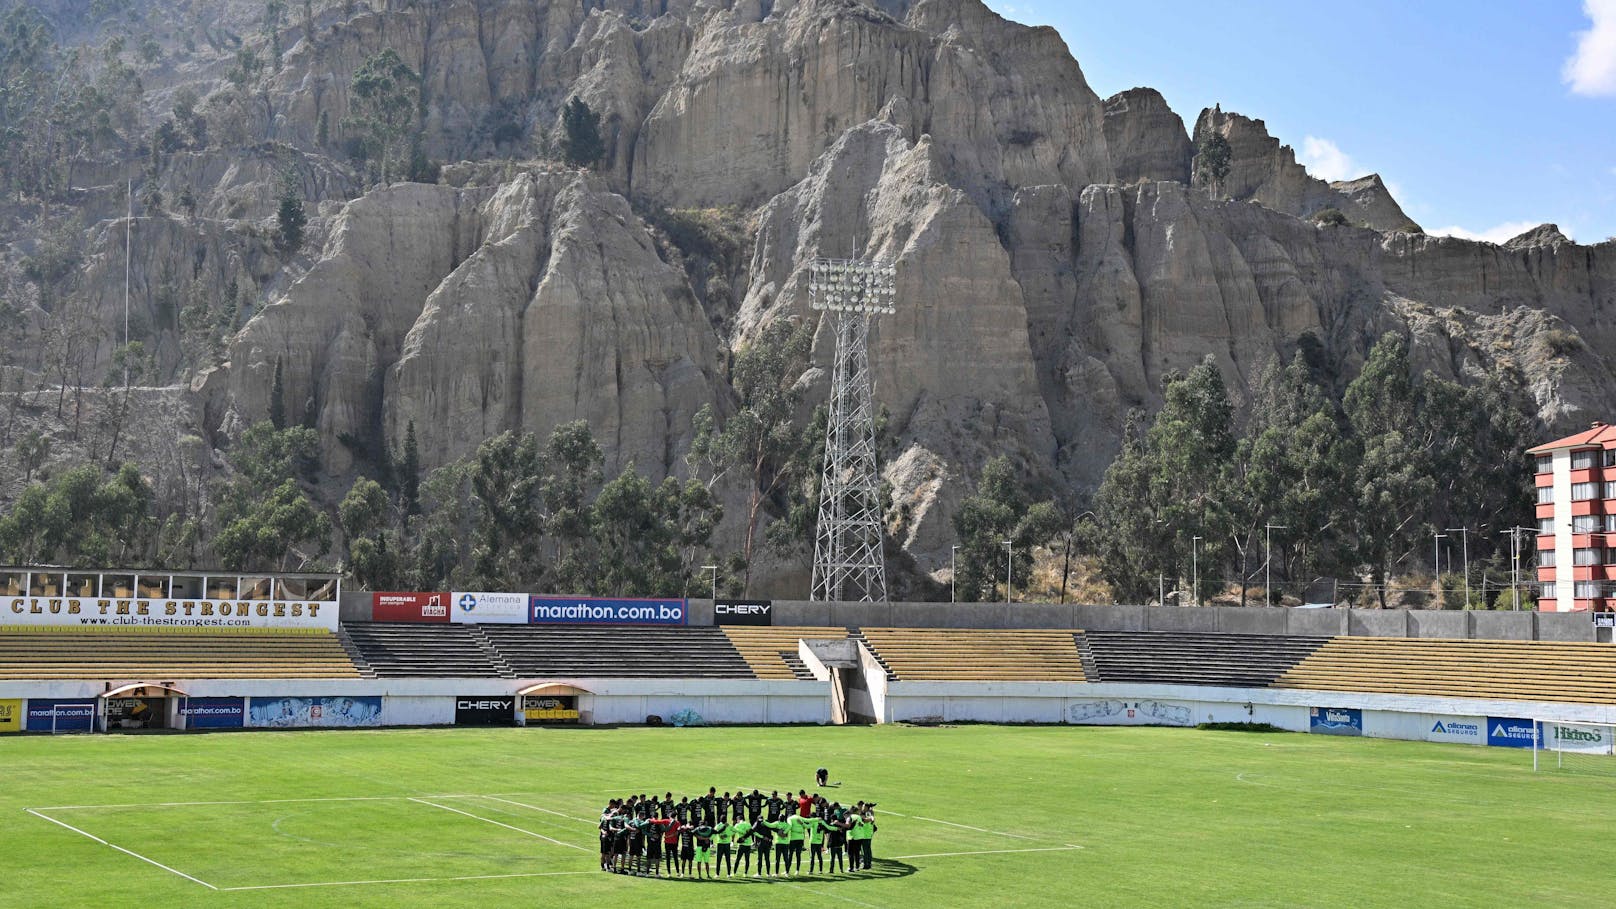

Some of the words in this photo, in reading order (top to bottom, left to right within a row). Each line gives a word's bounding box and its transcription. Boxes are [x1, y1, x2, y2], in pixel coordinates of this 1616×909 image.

[479, 594, 521, 605] Alemana
[11, 598, 81, 614] CLUB
[97, 599, 149, 615] THE
[165, 600, 320, 617] STRONGEST
[534, 603, 682, 621] marathon.com.bo
[715, 604, 771, 615] CHERY
[457, 700, 512, 710] CHERY
[1447, 729, 1478, 737] SEGUROS
